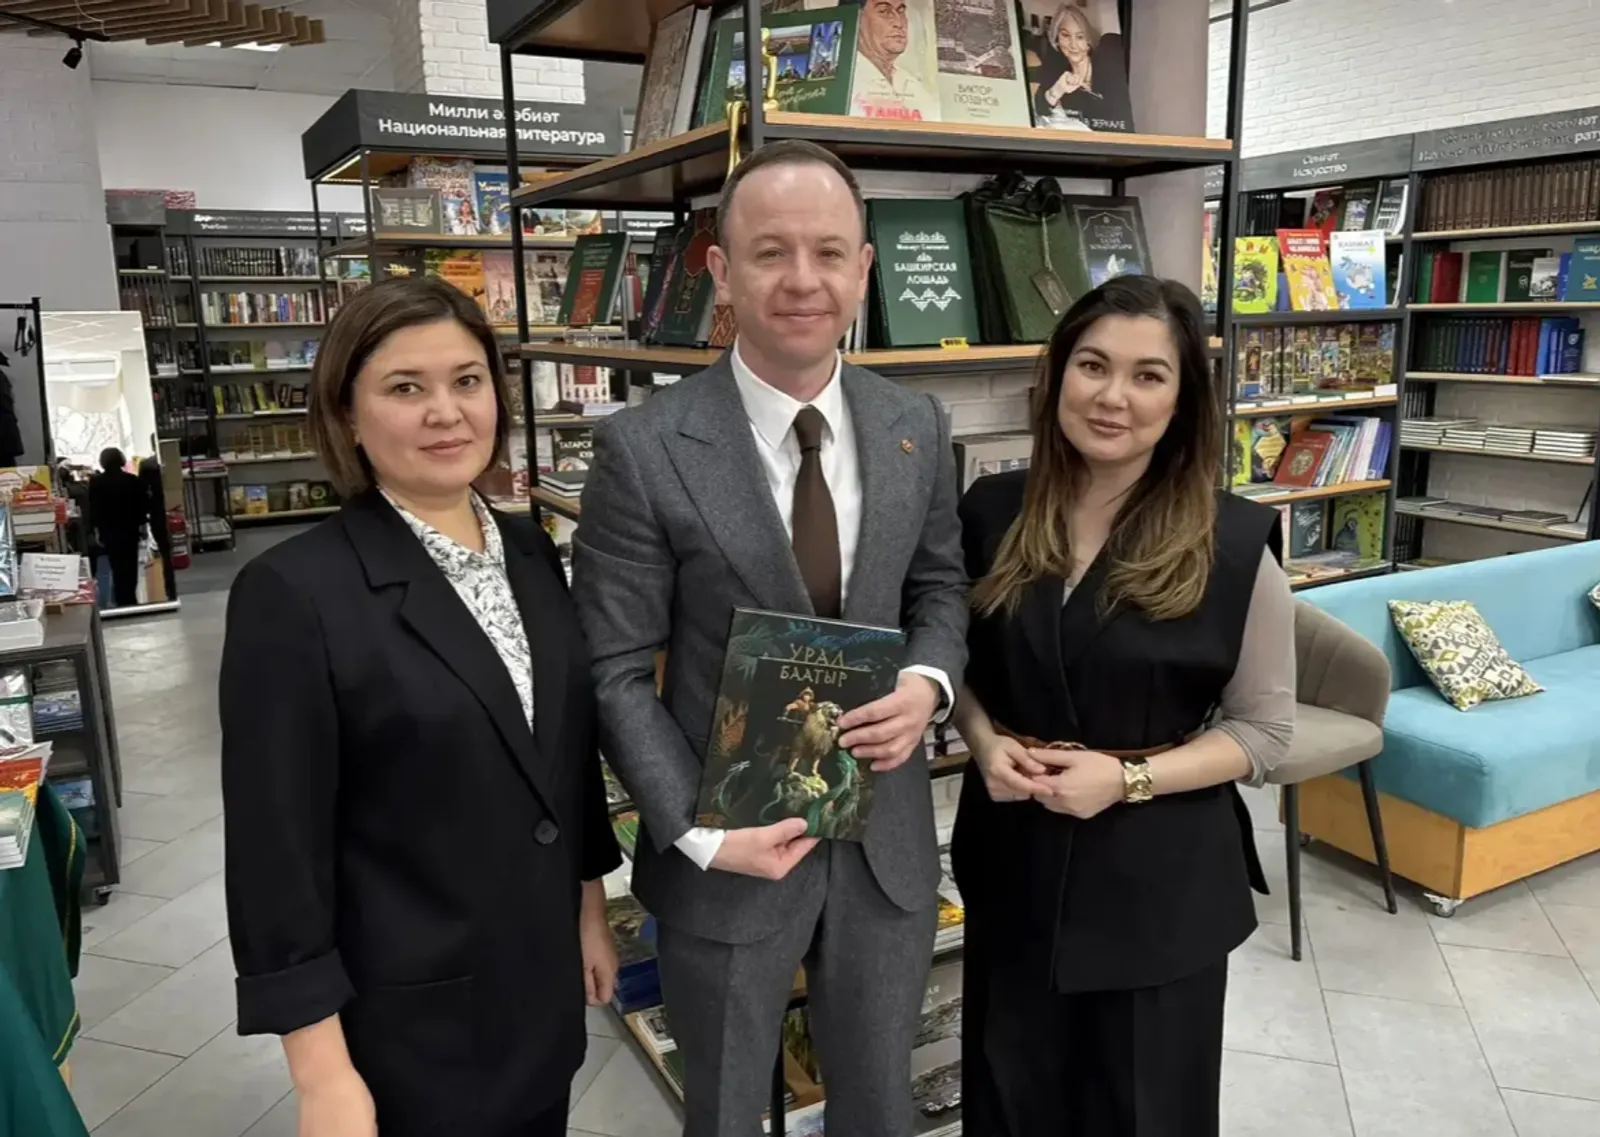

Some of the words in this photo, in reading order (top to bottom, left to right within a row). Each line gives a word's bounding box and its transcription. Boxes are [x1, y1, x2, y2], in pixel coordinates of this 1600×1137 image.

[428, 102, 489, 119] Милли
[378, 118, 507, 139] Национальная
[894, 262, 958, 273] БАШКИРСКАЯ
[906, 274, 950, 286] ЛОШАДЬ
[789, 642, 845, 668] УРАЛ
[780, 665, 849, 688] БААТЫР
